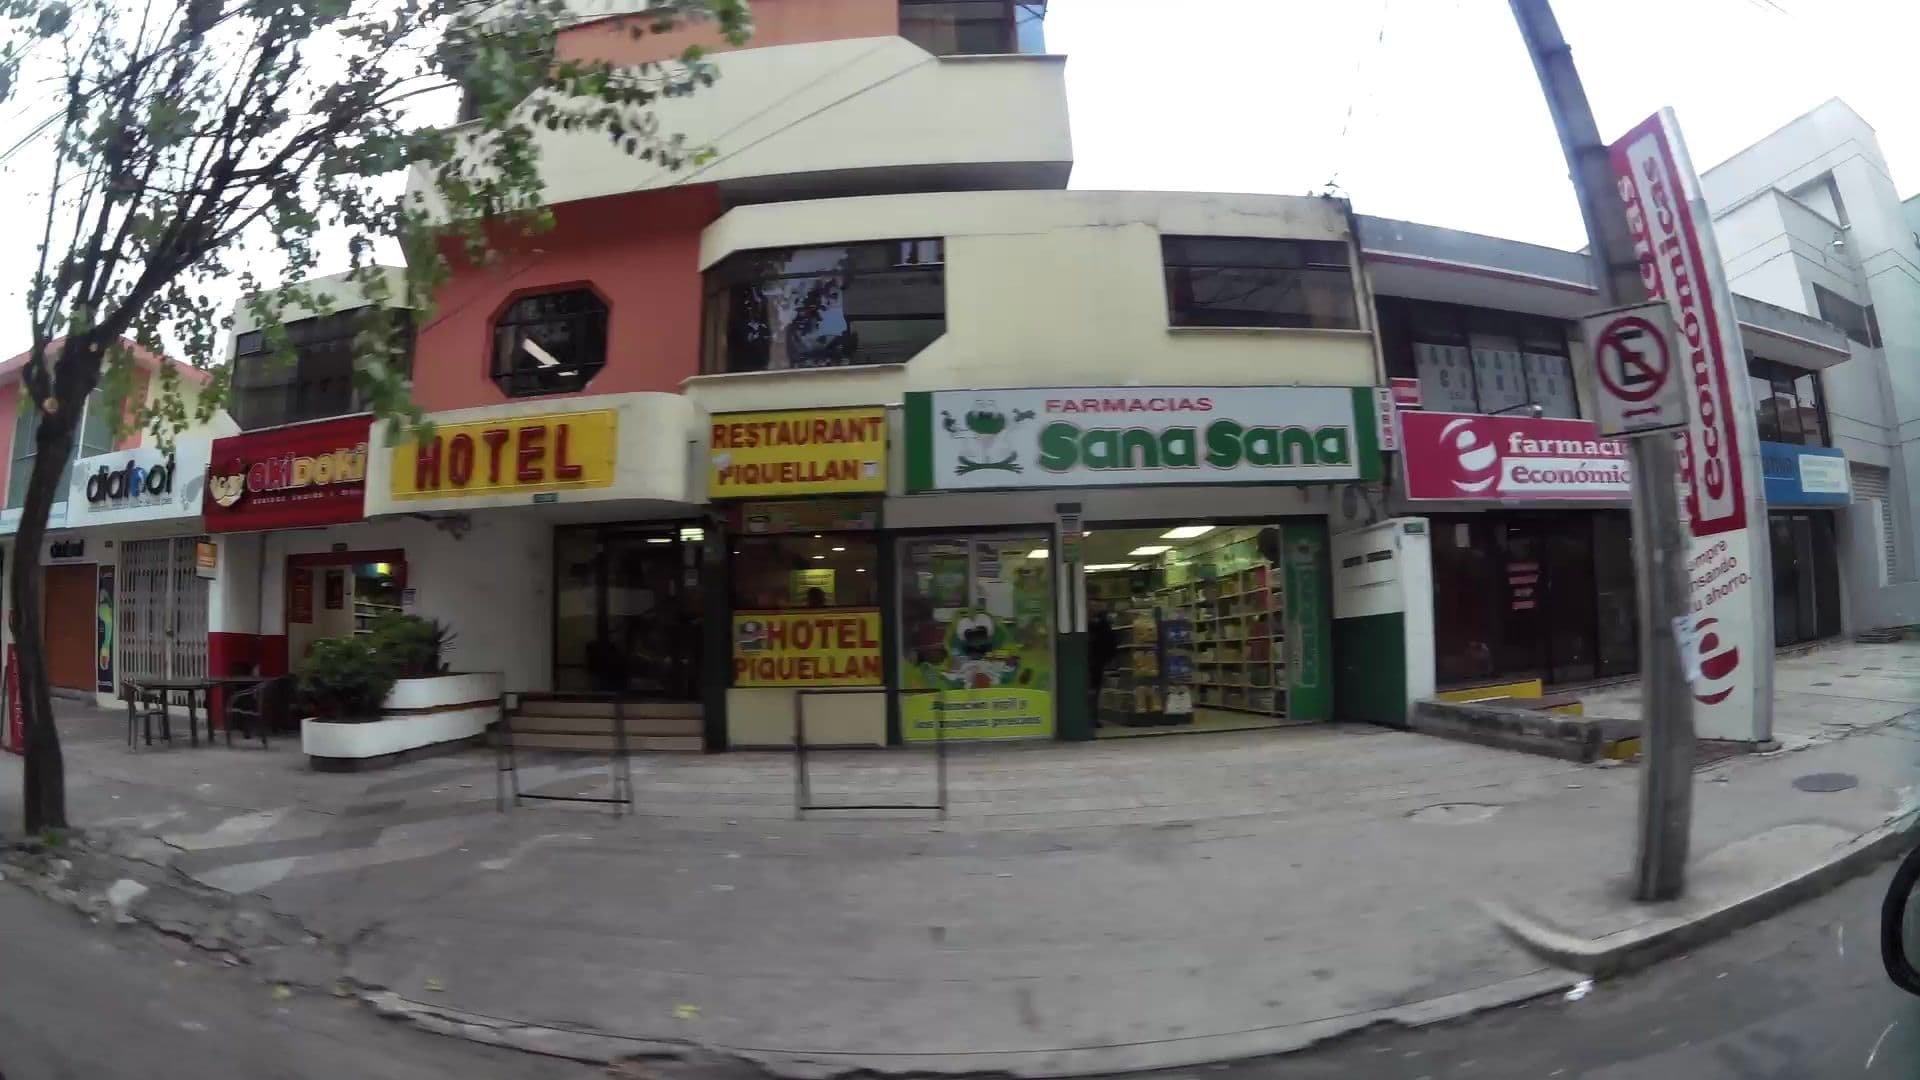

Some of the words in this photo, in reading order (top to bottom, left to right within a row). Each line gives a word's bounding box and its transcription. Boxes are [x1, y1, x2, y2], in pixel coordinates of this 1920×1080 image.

[1045, 397, 1213, 413] FARMACIAS
[712, 417, 884, 449] RESTAURANT
[1508, 431, 1629, 456] farmaci
[415, 423, 582, 491] HOTEL
[765, 619, 879, 651] HOTEL
[733, 656, 882, 680] PIQUELLAN
